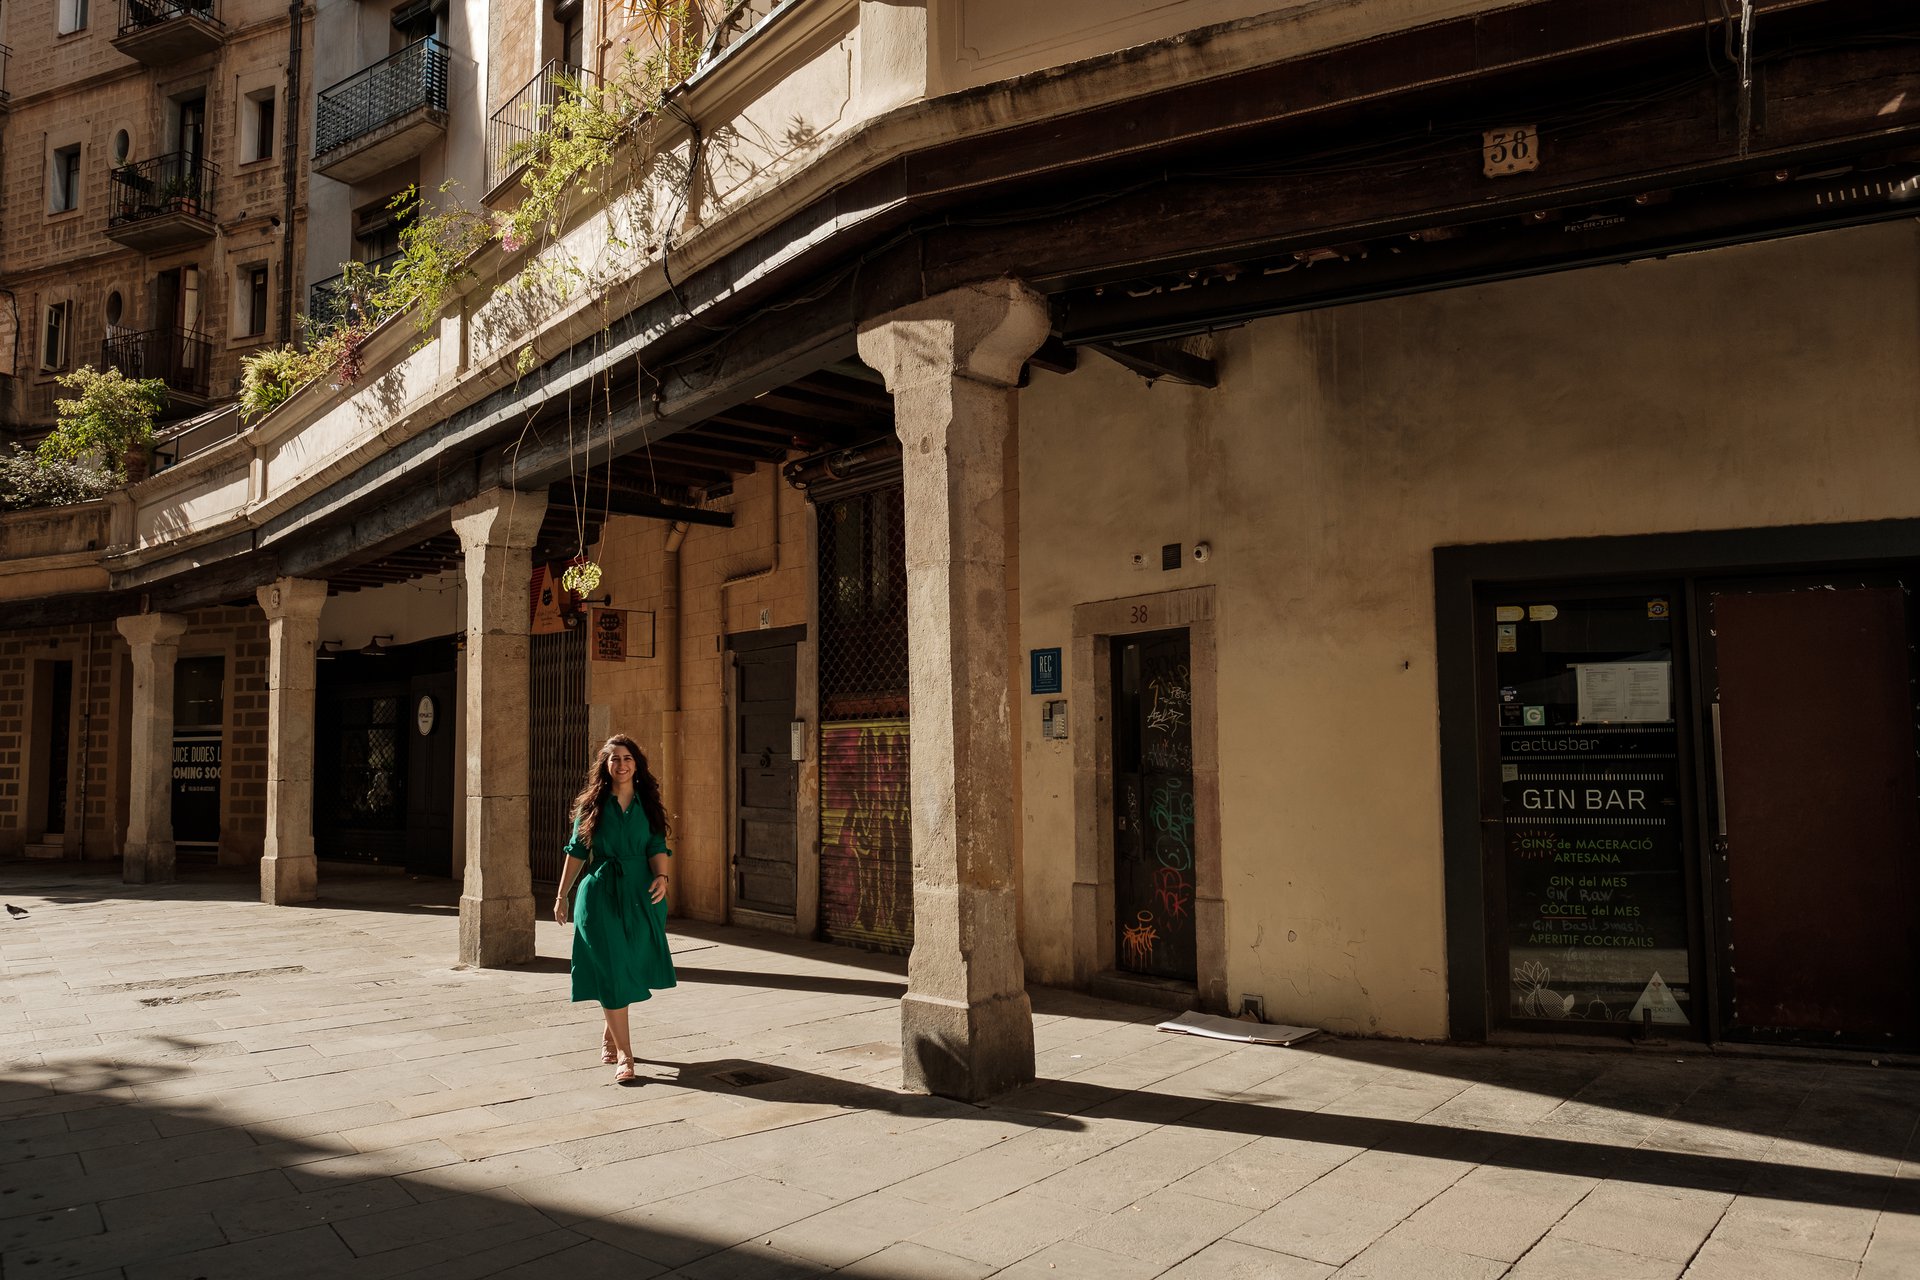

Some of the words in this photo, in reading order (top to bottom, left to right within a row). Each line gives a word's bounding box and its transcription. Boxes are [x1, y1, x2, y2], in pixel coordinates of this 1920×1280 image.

[1491, 130, 1529, 163] 38
[1564, 216, 1626, 232] FEVER-TREE
[760, 608, 769, 625] 40
[1130, 604, 1148, 624] 38
[1039, 655, 1052, 673] REC
[1511, 737, 1600, 752] cactusbar
[173, 746, 189, 762] UICE
[191, 746, 215, 762] DUDES
[173, 766, 203, 779] OMING
[1522, 788, 1576, 810] GIN
[1586, 789, 1648, 811] BAR
[1521, 838, 1553, 849] GINS
[1556, 838, 1571, 849] de
[1575, 837, 1653, 850] MACERACIÓ
[1553, 852, 1621, 864] ARTESANA
[1550, 876, 1574, 886] GIN
[1578, 876, 1596, 887] del
[1601, 877, 1628, 888] MES
[1546, 886, 1571, 902] GIN
[1540, 901, 1587, 915] CÒCTEL
[1591, 904, 1609, 916] del
[1614, 906, 1640, 917] MES
[1562, 919, 1599, 931] Basil
[1528, 933, 1579, 945] APERITIF
[1583, 935, 1655, 948] COCKTAILS
